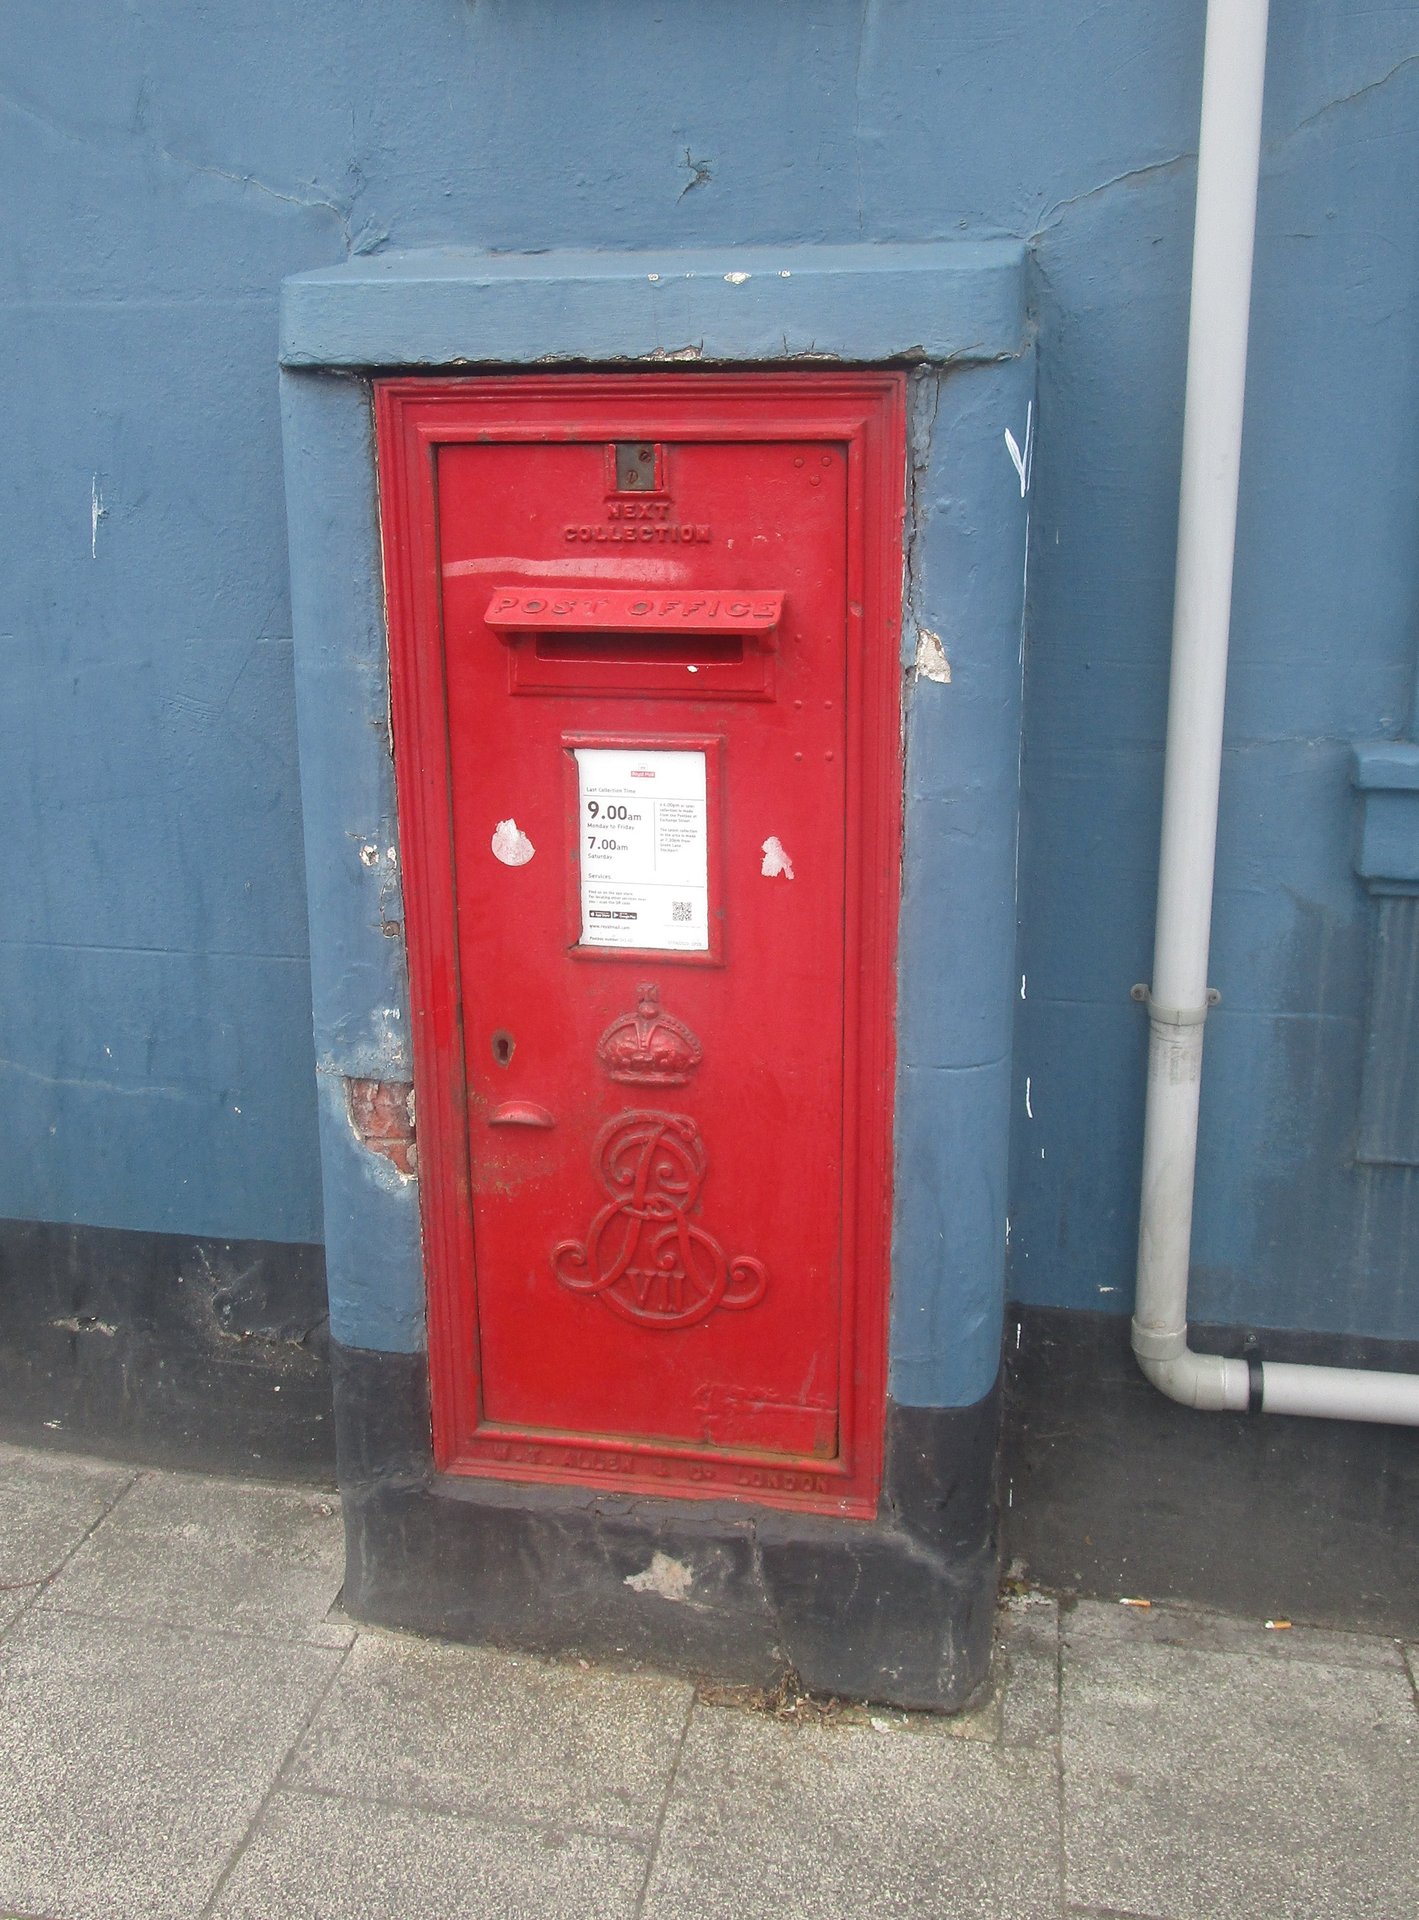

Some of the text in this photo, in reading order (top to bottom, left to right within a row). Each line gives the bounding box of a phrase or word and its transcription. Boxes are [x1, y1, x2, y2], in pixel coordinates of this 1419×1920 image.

[607, 503, 671, 521] NEXT
[563, 524, 711, 544] COLLECTION
[493, 596, 777, 618] POST OFFICE
[587, 800, 642, 821] 9.00am
[587, 836, 629, 851] 7.00am
[588, 872, 612, 880] Services
[734, 1469, 829, 1496] LONDON
